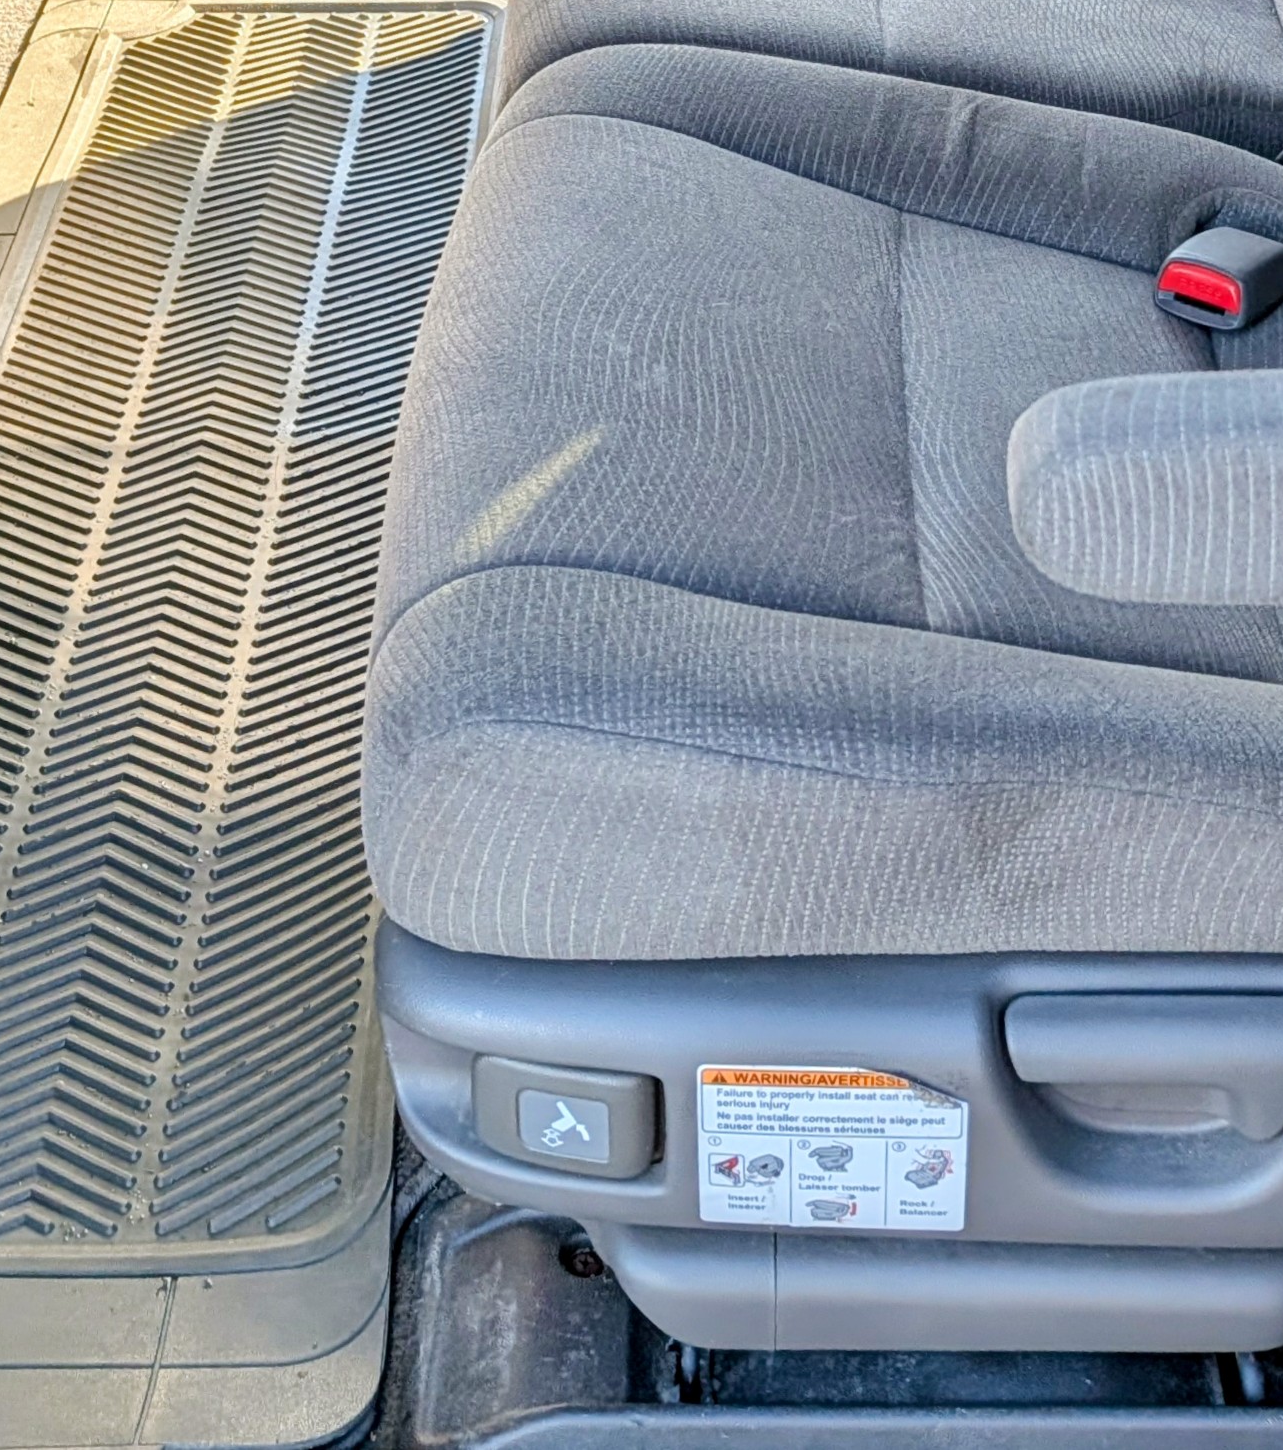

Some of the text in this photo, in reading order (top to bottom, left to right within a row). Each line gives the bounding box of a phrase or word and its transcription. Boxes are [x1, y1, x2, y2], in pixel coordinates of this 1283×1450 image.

[716, 1088, 753, 1098] Failure
[756, 1090, 767, 1098] to
[770, 1091, 815, 1102] properly
[818, 1091, 851, 1101] install
[854, 1092, 877, 1101] seat
[717, 1099, 790, 1110] serious injury
[717, 1111, 946, 1127] Ne pas installer correctement le siège peut
[717, 1122, 885, 1134] causer des blessures sérieuses
[798, 1173, 825, 1182] Drop
[798, 1183, 881, 1192] Laisser tomber
[728, 1194, 758, 1202] Insert
[728, 1202, 766, 1210] Insérer
[899, 1200, 928, 1208] Rock
[899, 1209, 948, 1217] Balancer
